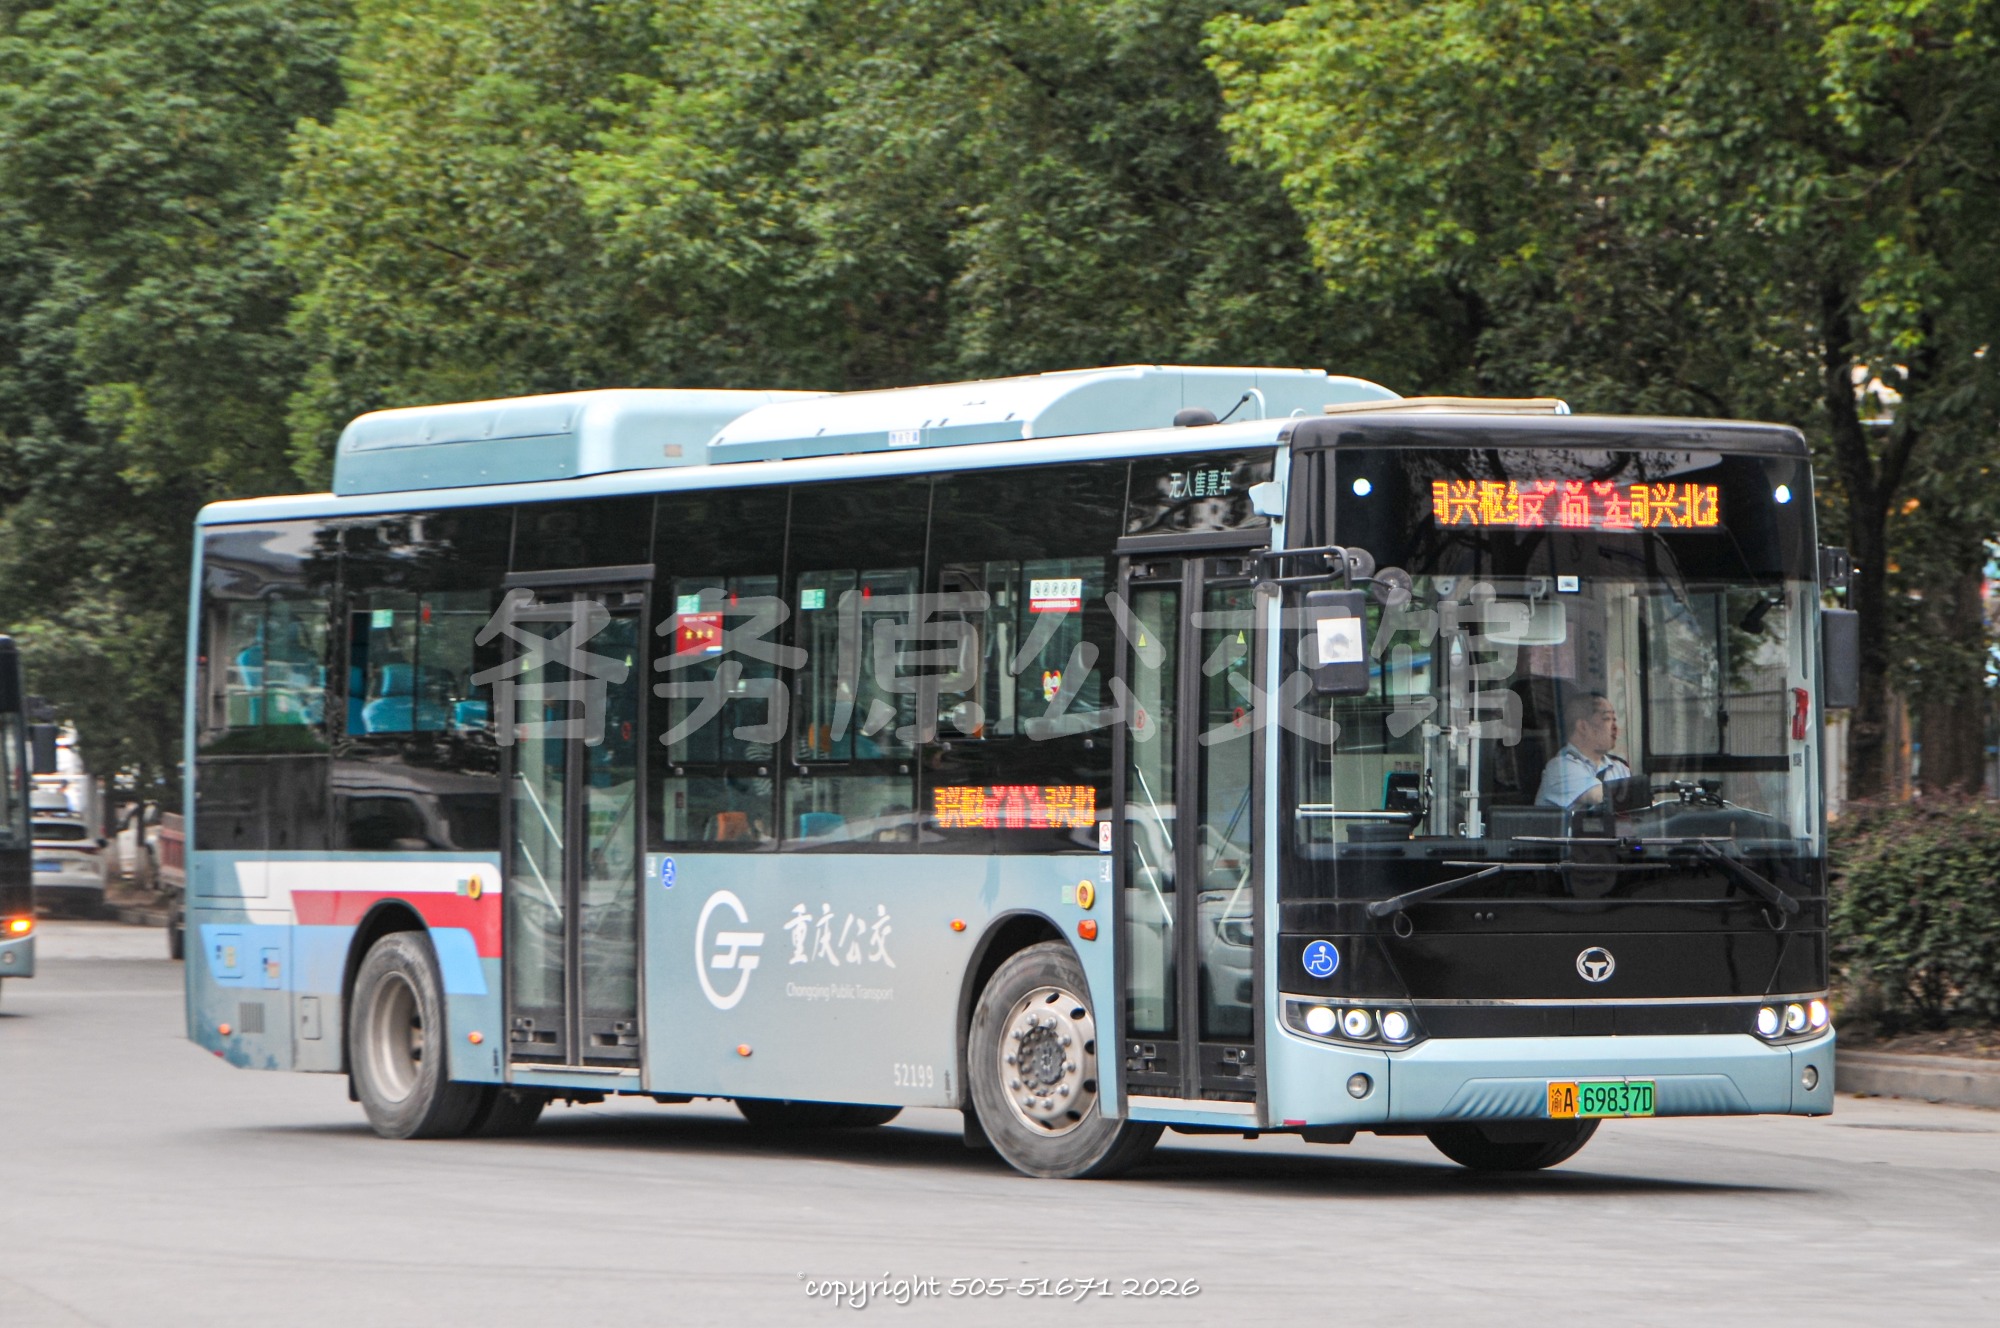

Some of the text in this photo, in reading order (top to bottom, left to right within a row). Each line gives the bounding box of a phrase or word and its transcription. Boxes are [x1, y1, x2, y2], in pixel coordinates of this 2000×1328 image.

[1169, 468, 1232, 498] 无人售票车
[783, 903, 896, 968] 重庆公交
[786, 982, 894, 1003] Chongqing Public Transport
[893, 1063, 934, 1088] 52199
[1583, 1086, 1653, 1112] 69837D
